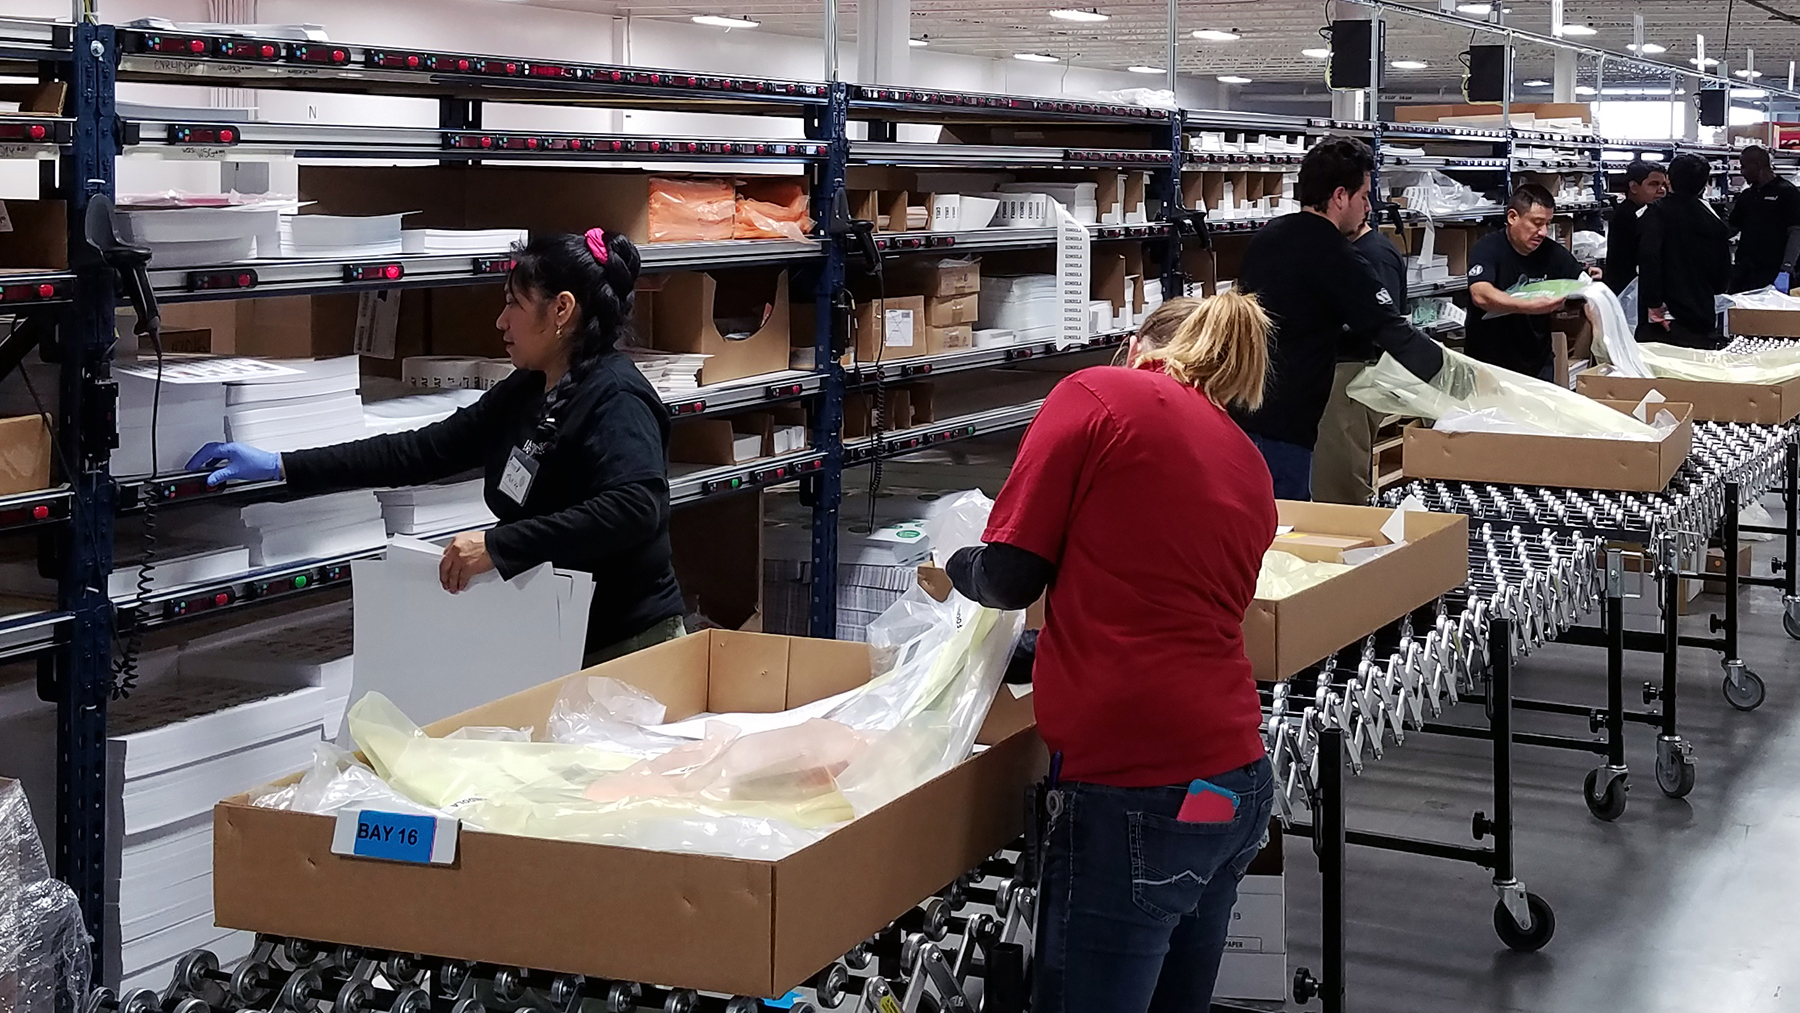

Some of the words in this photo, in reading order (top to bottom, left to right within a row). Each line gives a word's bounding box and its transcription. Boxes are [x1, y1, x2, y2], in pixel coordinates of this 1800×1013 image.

[308, 105, 317, 119] N
[357, 822, 394, 842] BAY
[398, 828, 418, 845] 16
